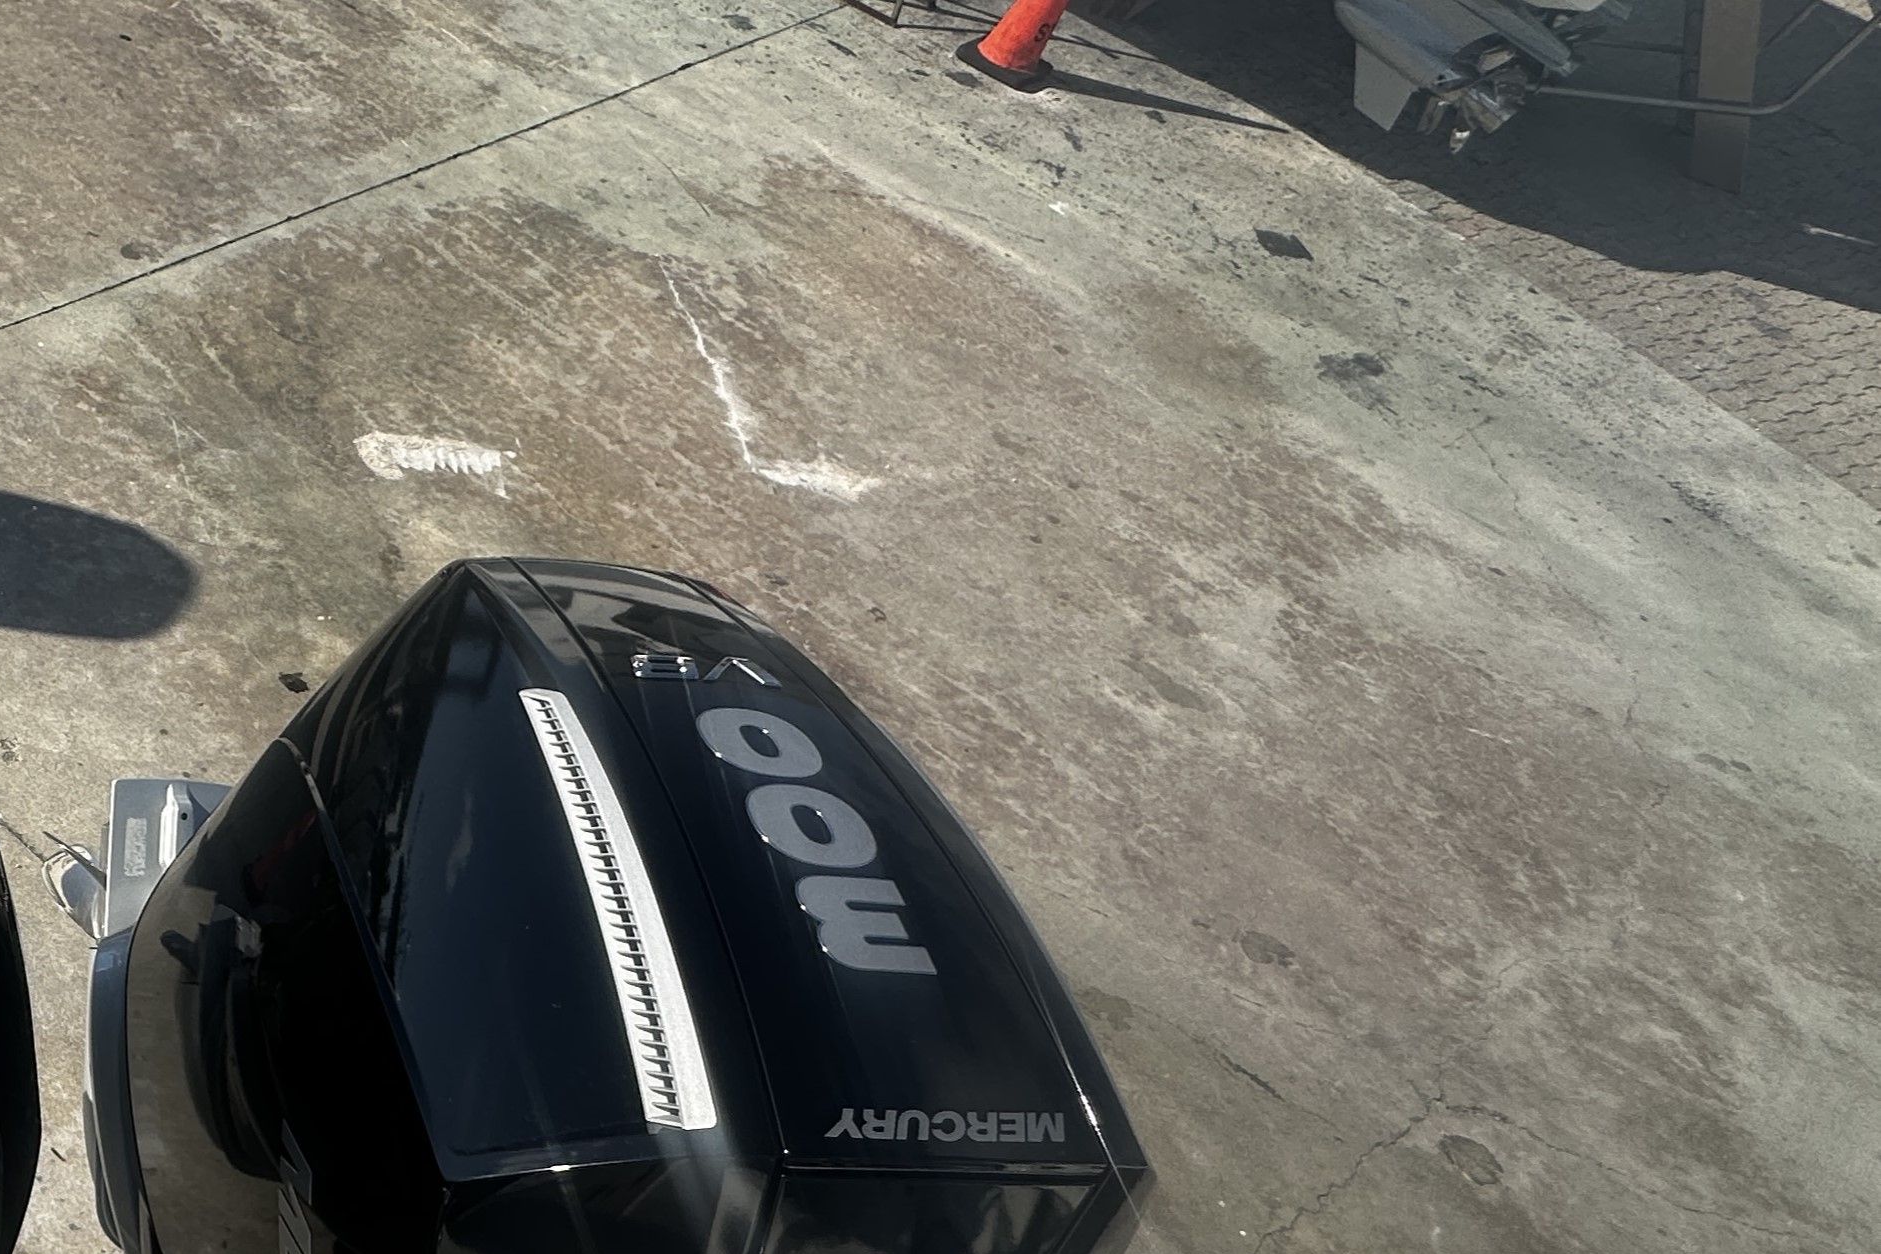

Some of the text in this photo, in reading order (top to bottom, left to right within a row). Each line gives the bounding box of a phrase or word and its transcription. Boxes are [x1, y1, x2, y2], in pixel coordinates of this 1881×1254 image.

[630, 654, 783, 688] V8
[696, 707, 938, 976] 300
[824, 1107, 1066, 1143] MERCURY
